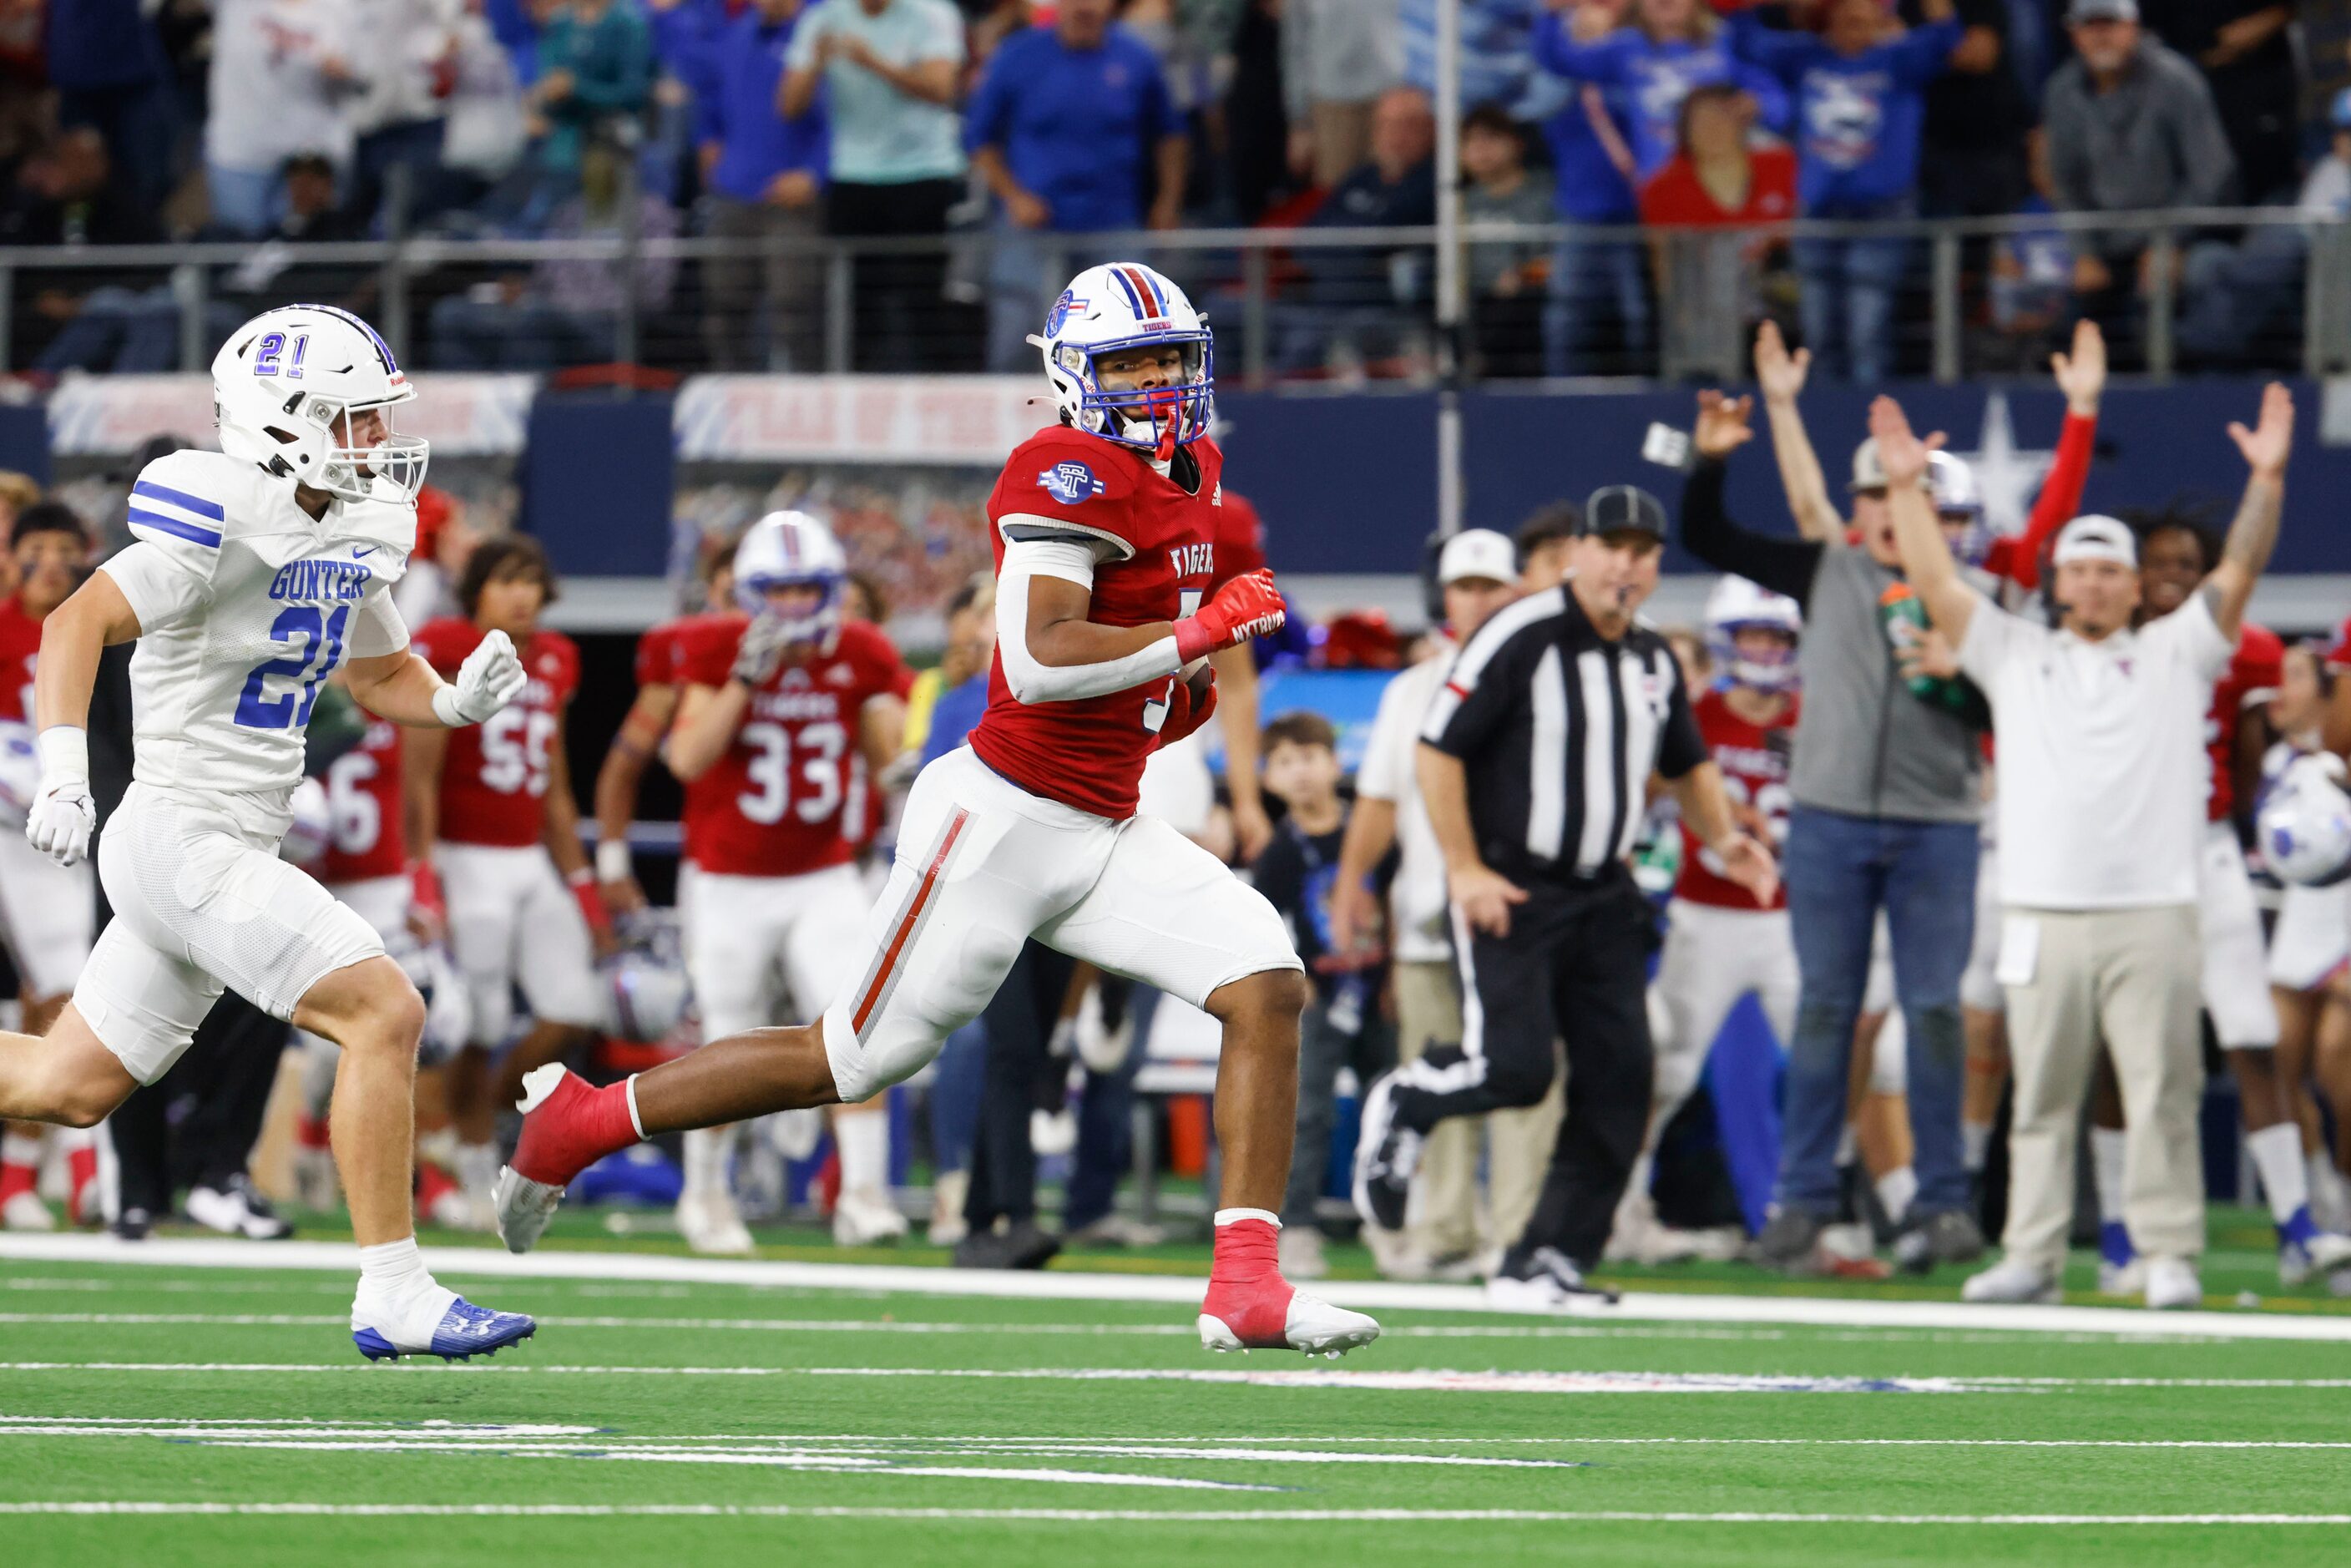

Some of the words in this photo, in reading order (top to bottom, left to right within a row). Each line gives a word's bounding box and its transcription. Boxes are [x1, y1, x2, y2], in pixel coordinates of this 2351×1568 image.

[1142, 321, 1172, 332] TIGERS
[254, 332, 309, 379] 21
[268, 560, 372, 599] GUNTER
[234, 605, 350, 728] 21
[737, 721, 847, 827] 33
